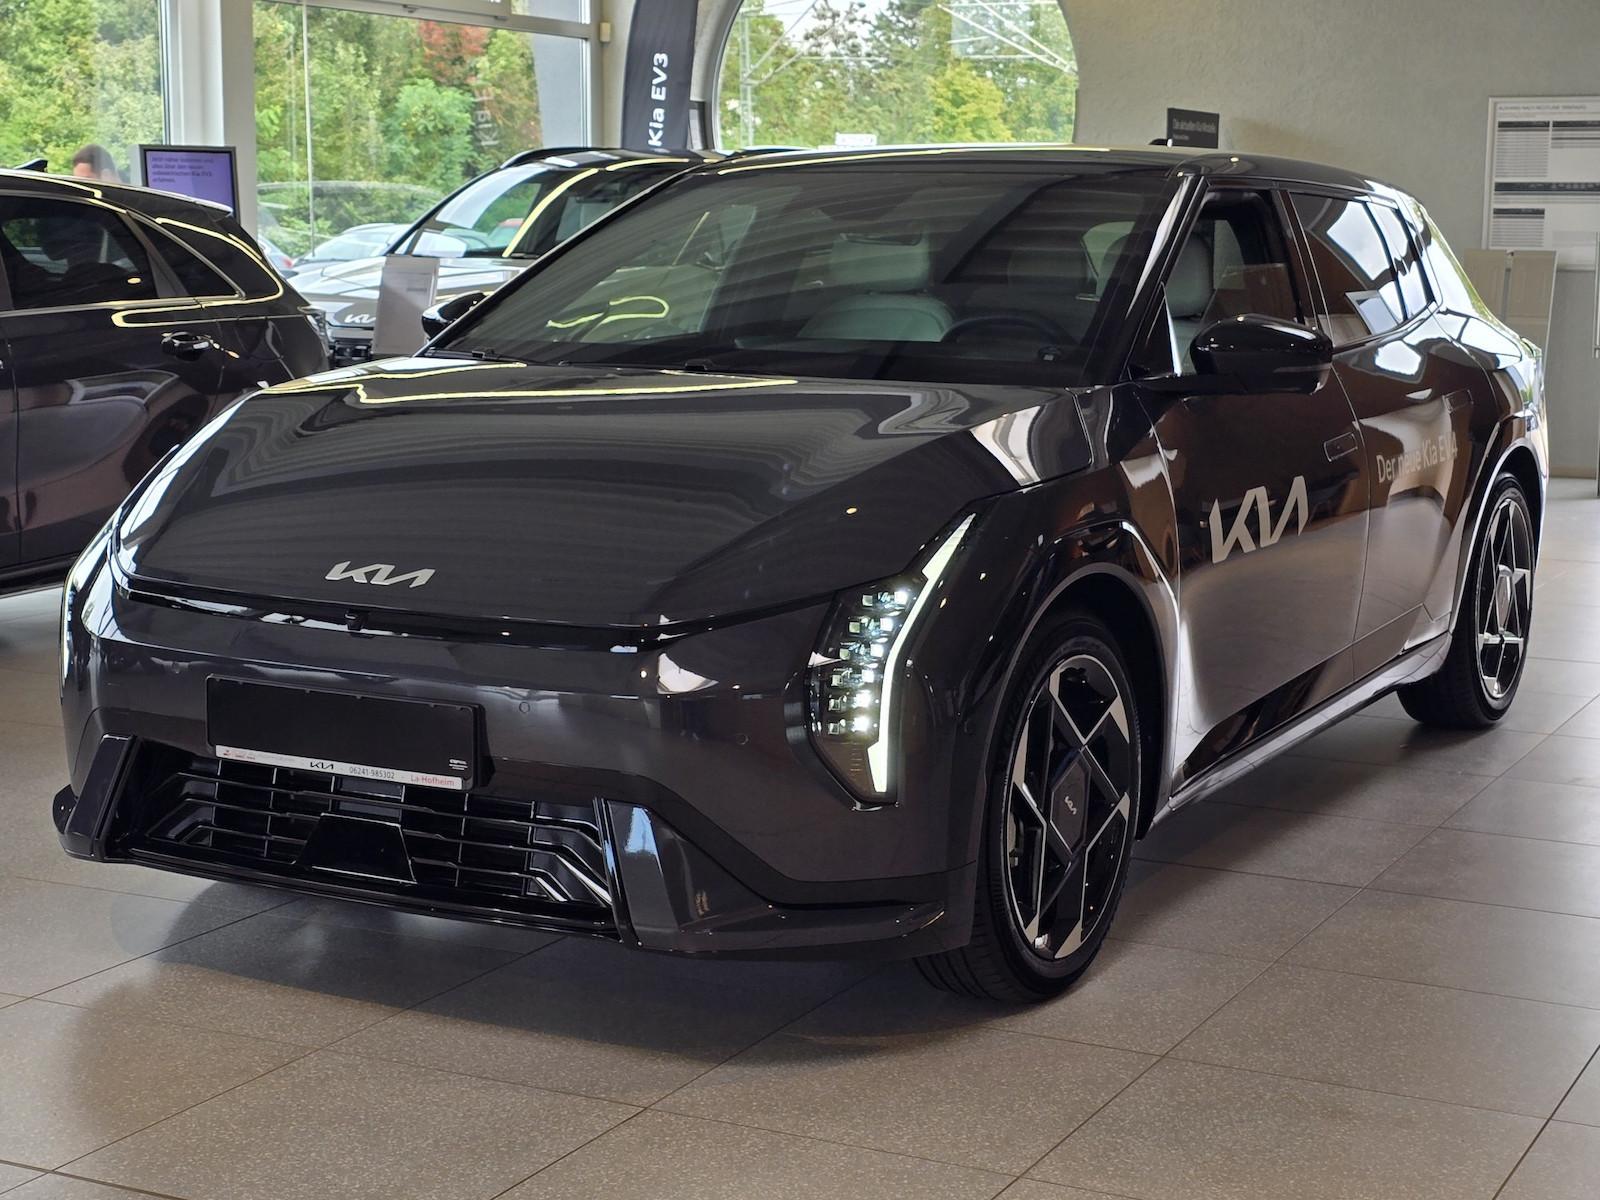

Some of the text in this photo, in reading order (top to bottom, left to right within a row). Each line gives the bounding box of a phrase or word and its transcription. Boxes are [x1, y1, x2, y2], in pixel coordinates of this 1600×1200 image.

[648, 53, 668, 147] Kia EV3
[1376, 454, 1396, 484] Der
[1422, 439, 1439, 469] Kia
[1209, 475, 1309, 564] KIA
[325, 560, 436, 588] KIA
[310, 761, 334, 770] KIA
